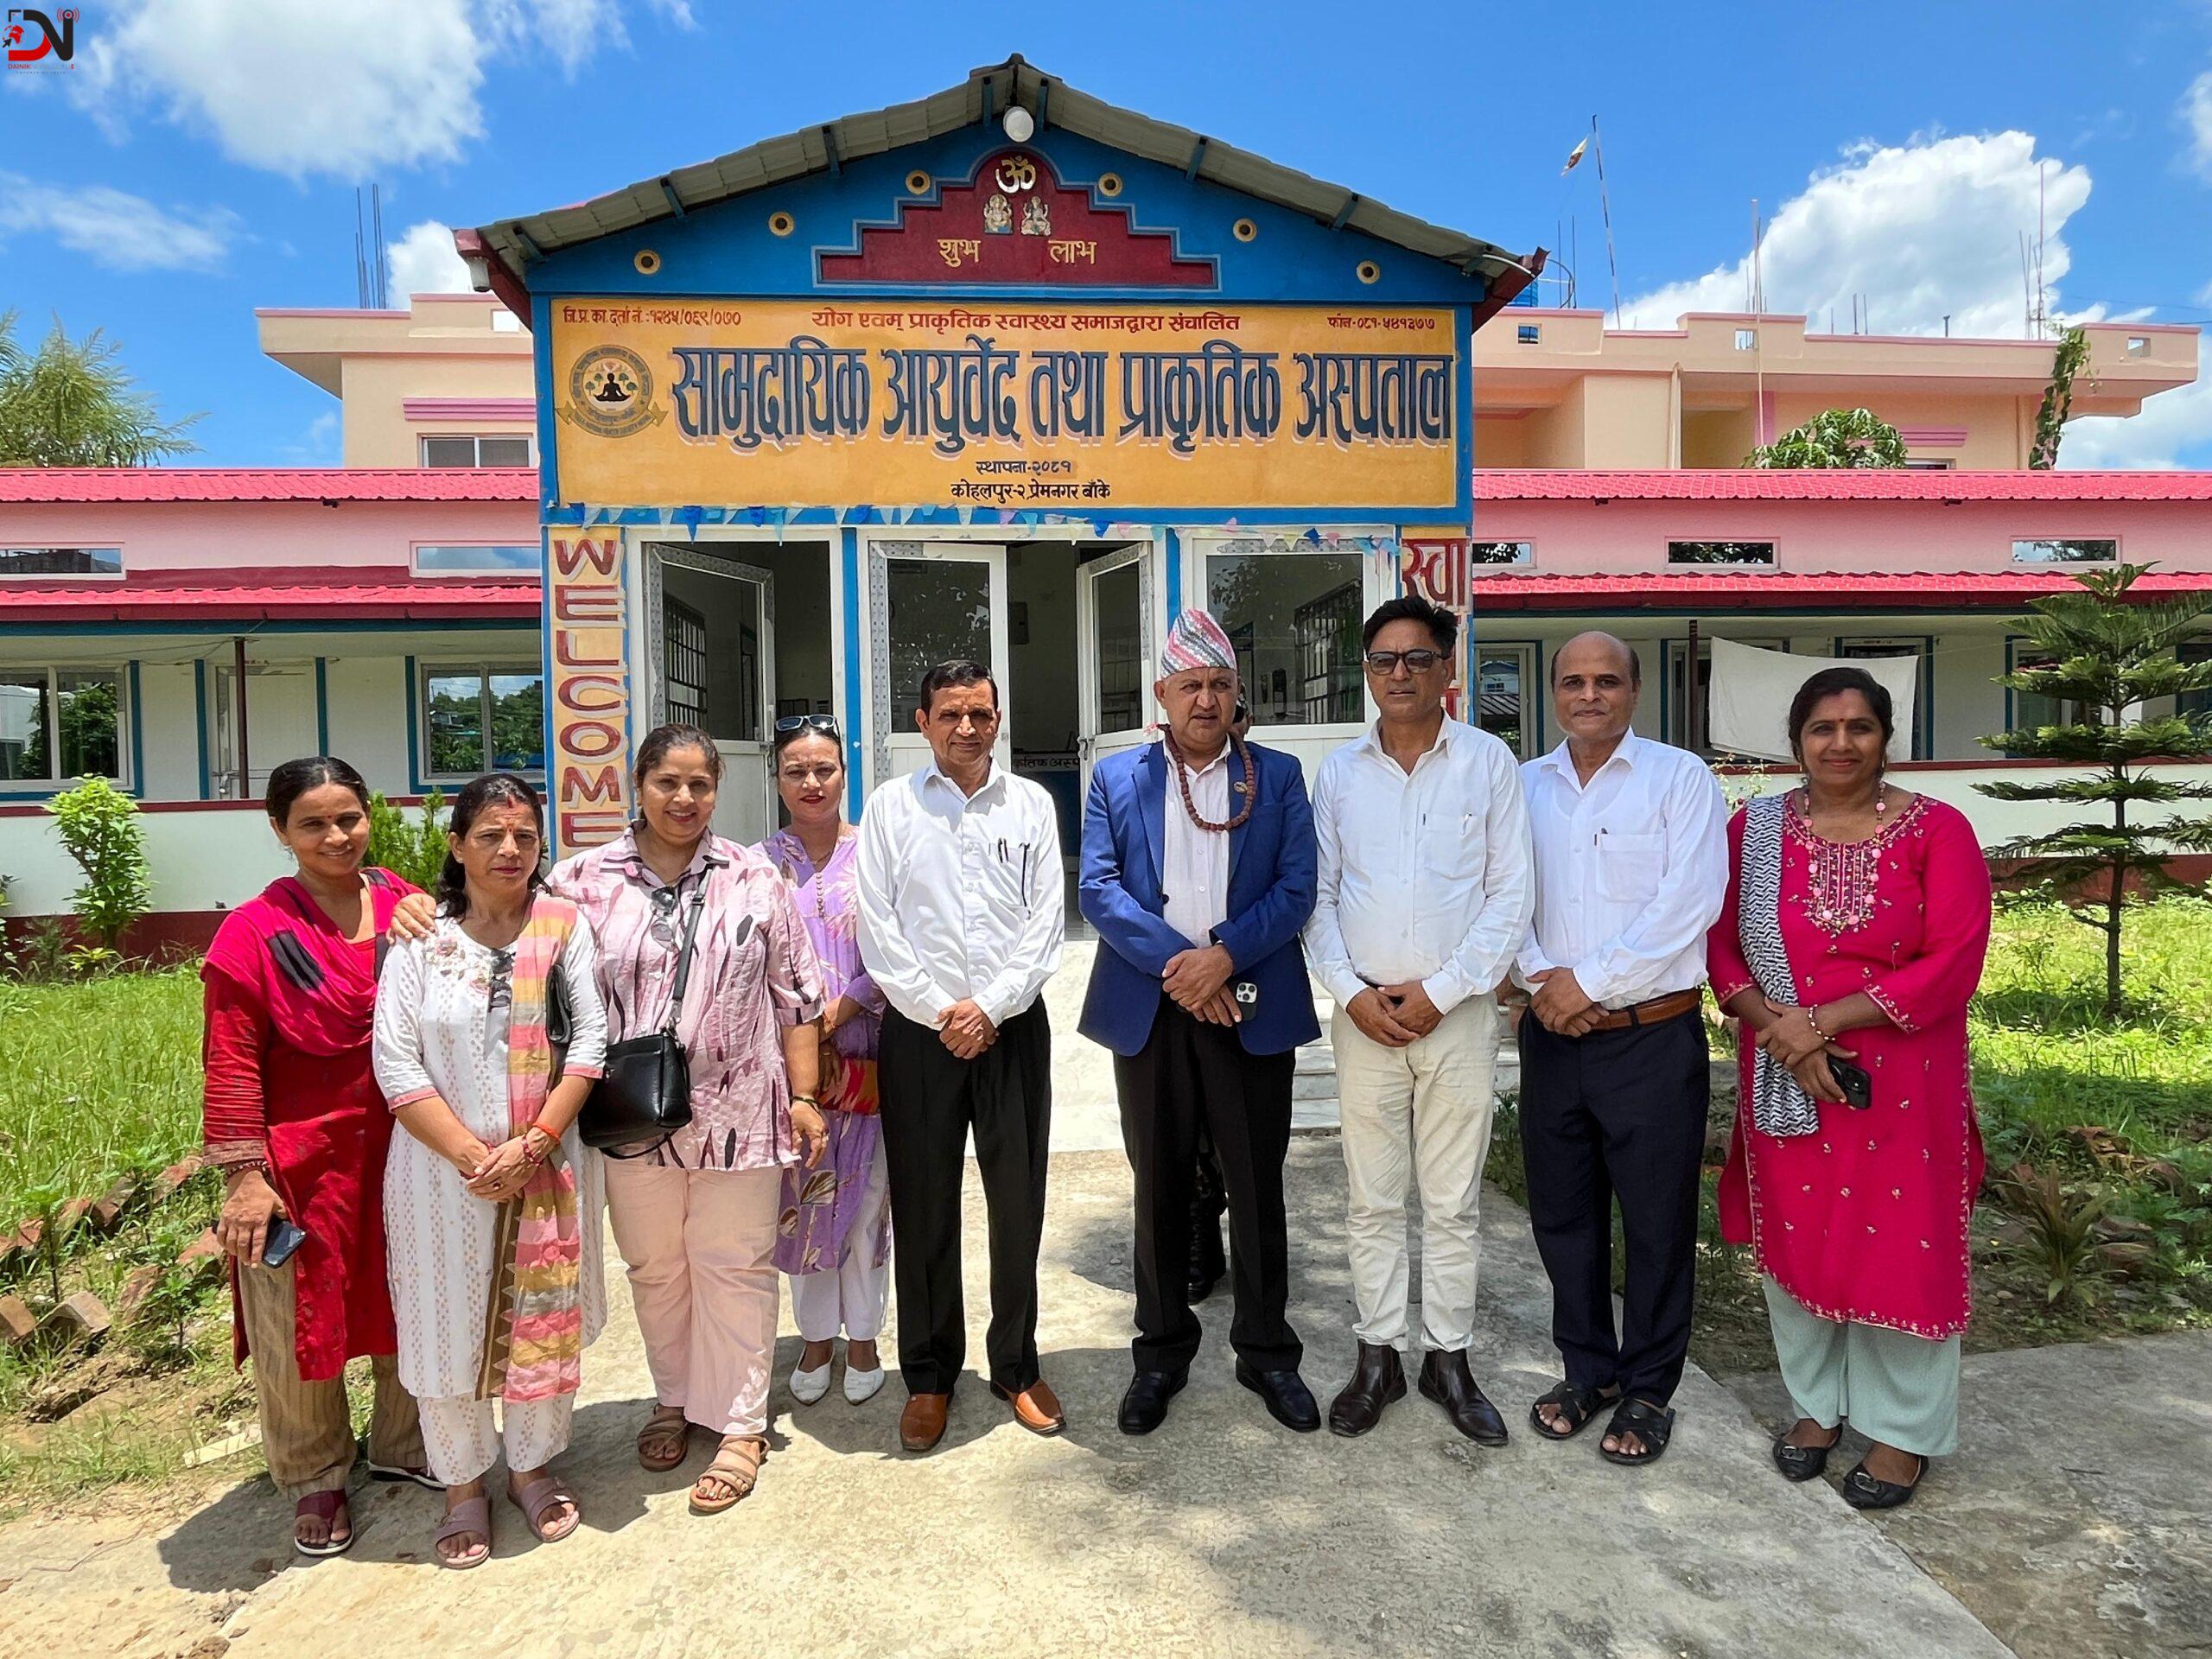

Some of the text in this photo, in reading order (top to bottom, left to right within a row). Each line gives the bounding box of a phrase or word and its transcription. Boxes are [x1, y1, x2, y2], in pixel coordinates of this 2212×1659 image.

[937, 238, 1097, 268] शुभ लाभ
[811, 307, 1242, 335] योग एवम् प्राकृतिक स्वास्थ्य समाजद्वारा संचालित
[671, 334, 871, 448] सामुदायिक
[880, 333, 1022, 453] आयुर्वेद
[1030, 349, 1109, 438] तथा
[1118, 339, 1282, 453] प्राकृतिक
[1293, 352, 1455, 443] अस्पताल
[553, 538, 625, 849] WELCOME
